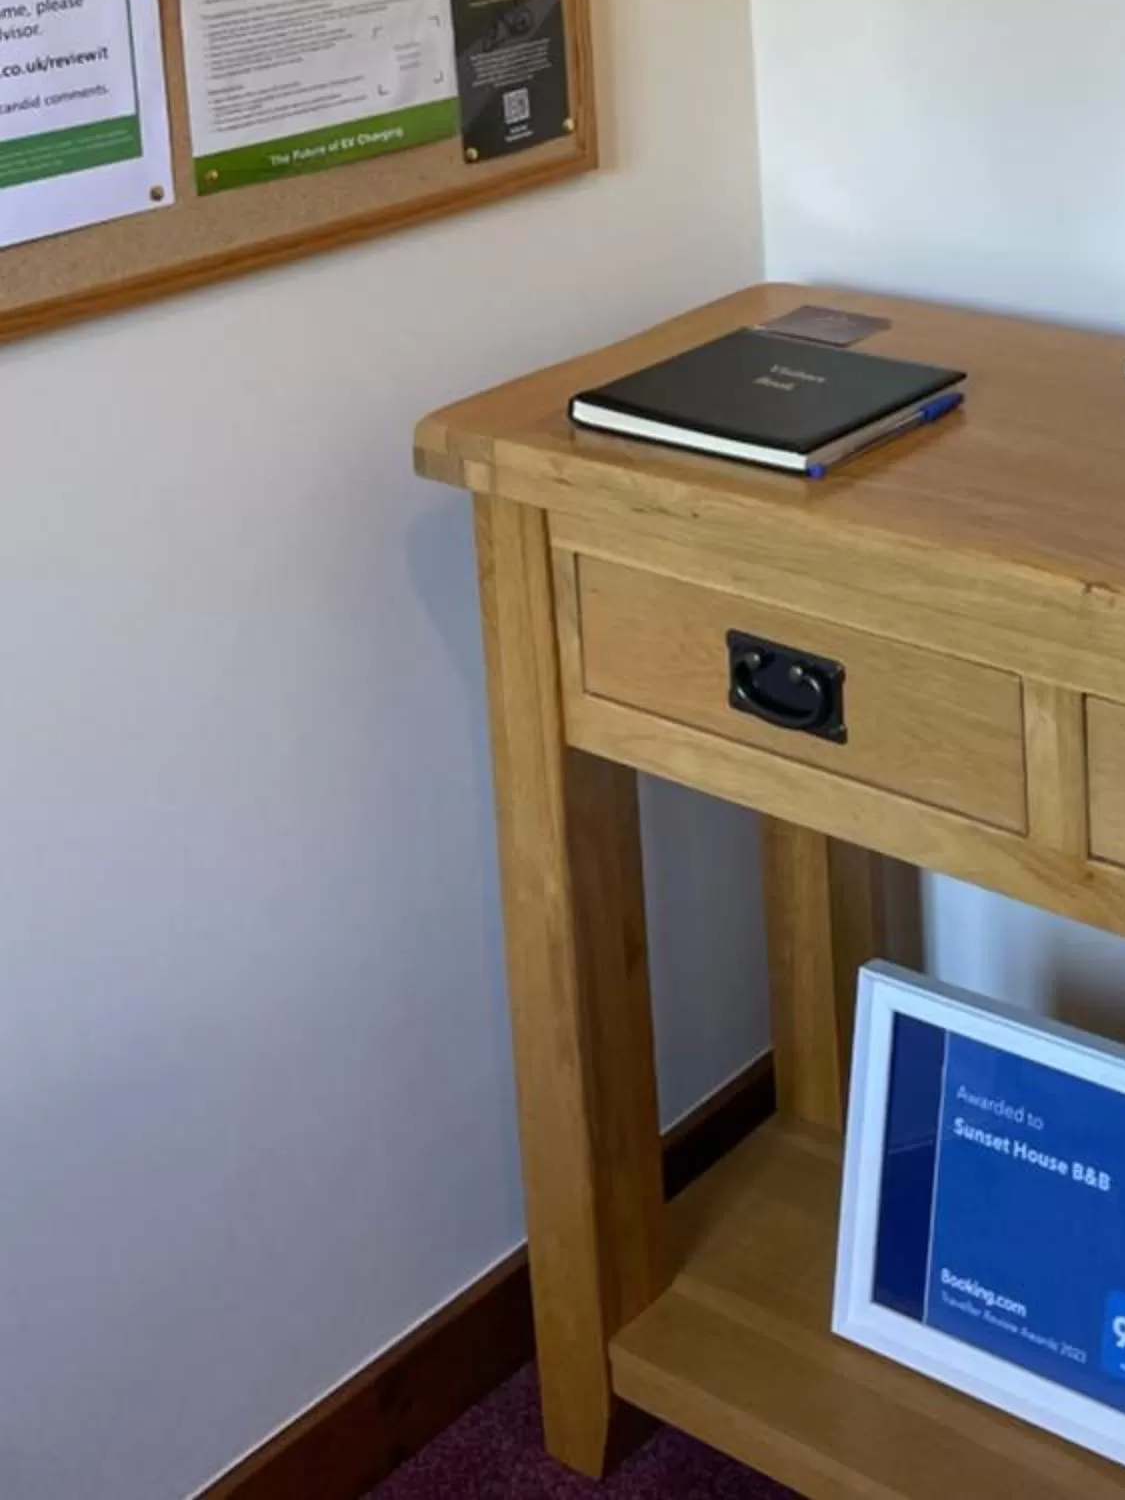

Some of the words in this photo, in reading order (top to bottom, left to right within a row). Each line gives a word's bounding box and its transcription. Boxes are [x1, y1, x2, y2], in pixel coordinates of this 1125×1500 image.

[956, 1084, 1025, 1124] Awarded
[1026, 1111, 1045, 1131] to
[953, 1115, 1010, 1155] Sunset
[1013, 1139, 1069, 1176] House
[1071, 1161, 1112, 1193] B&B
[940, 1266, 1028, 1318] Booking.com
